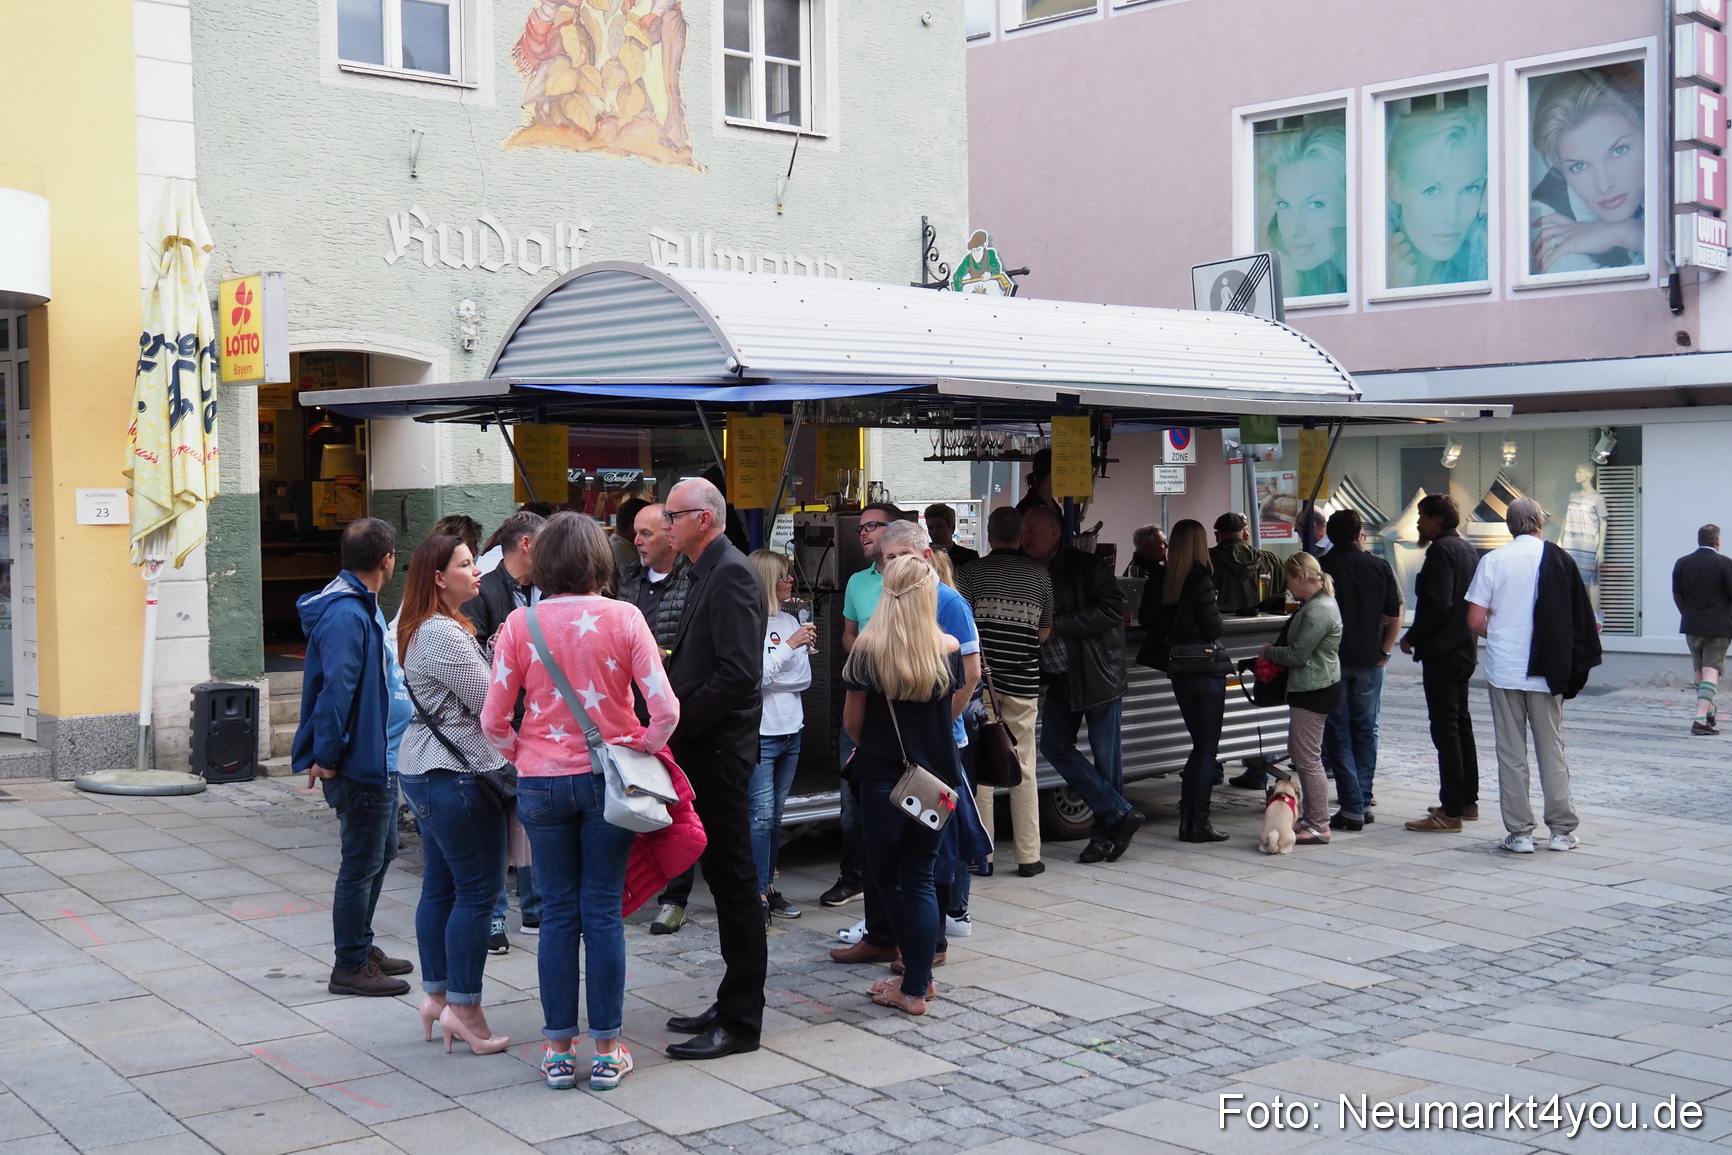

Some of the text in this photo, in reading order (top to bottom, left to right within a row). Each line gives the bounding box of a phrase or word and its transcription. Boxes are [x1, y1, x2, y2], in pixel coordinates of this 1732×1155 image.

[1700, 0, 1719, 200] ITT
[1698, 215, 1727, 246] WITT
[226, 332, 260, 357] LOTTO
[233, 364, 253, 377] Bayern
[1171, 453, 1189, 461] ZONE
[603, 472, 639, 489] Davidoff
[96, 507, 110, 518] 23
